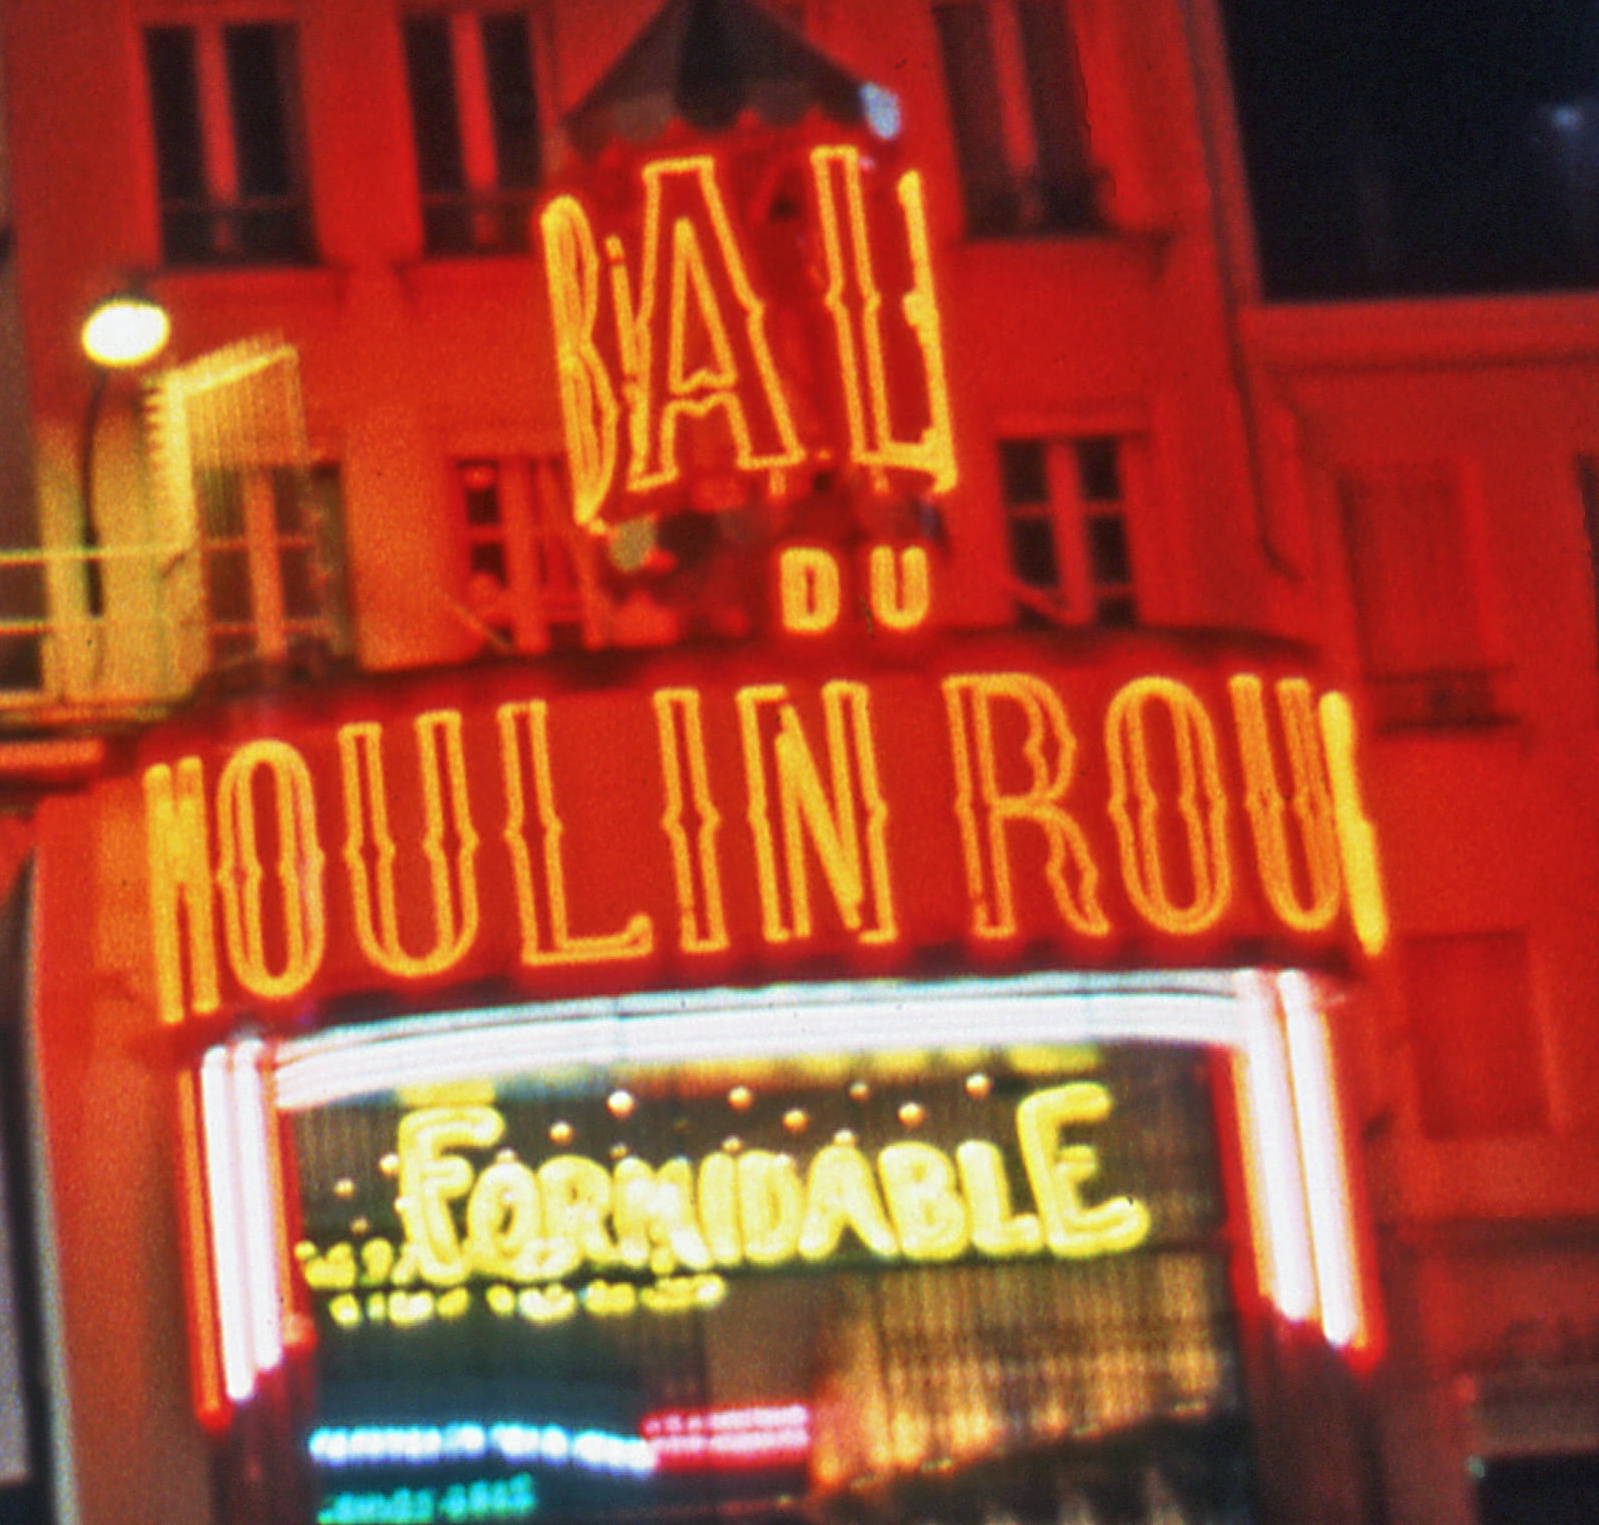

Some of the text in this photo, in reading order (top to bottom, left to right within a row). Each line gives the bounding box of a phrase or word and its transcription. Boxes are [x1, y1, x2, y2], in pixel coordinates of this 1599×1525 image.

[541, 145, 957, 529] BAL
[778, 545, 930, 633] DU
[143, 680, 897, 1025] MOULIN
[398, 1083, 1151, 1285] FORMIDABLE
